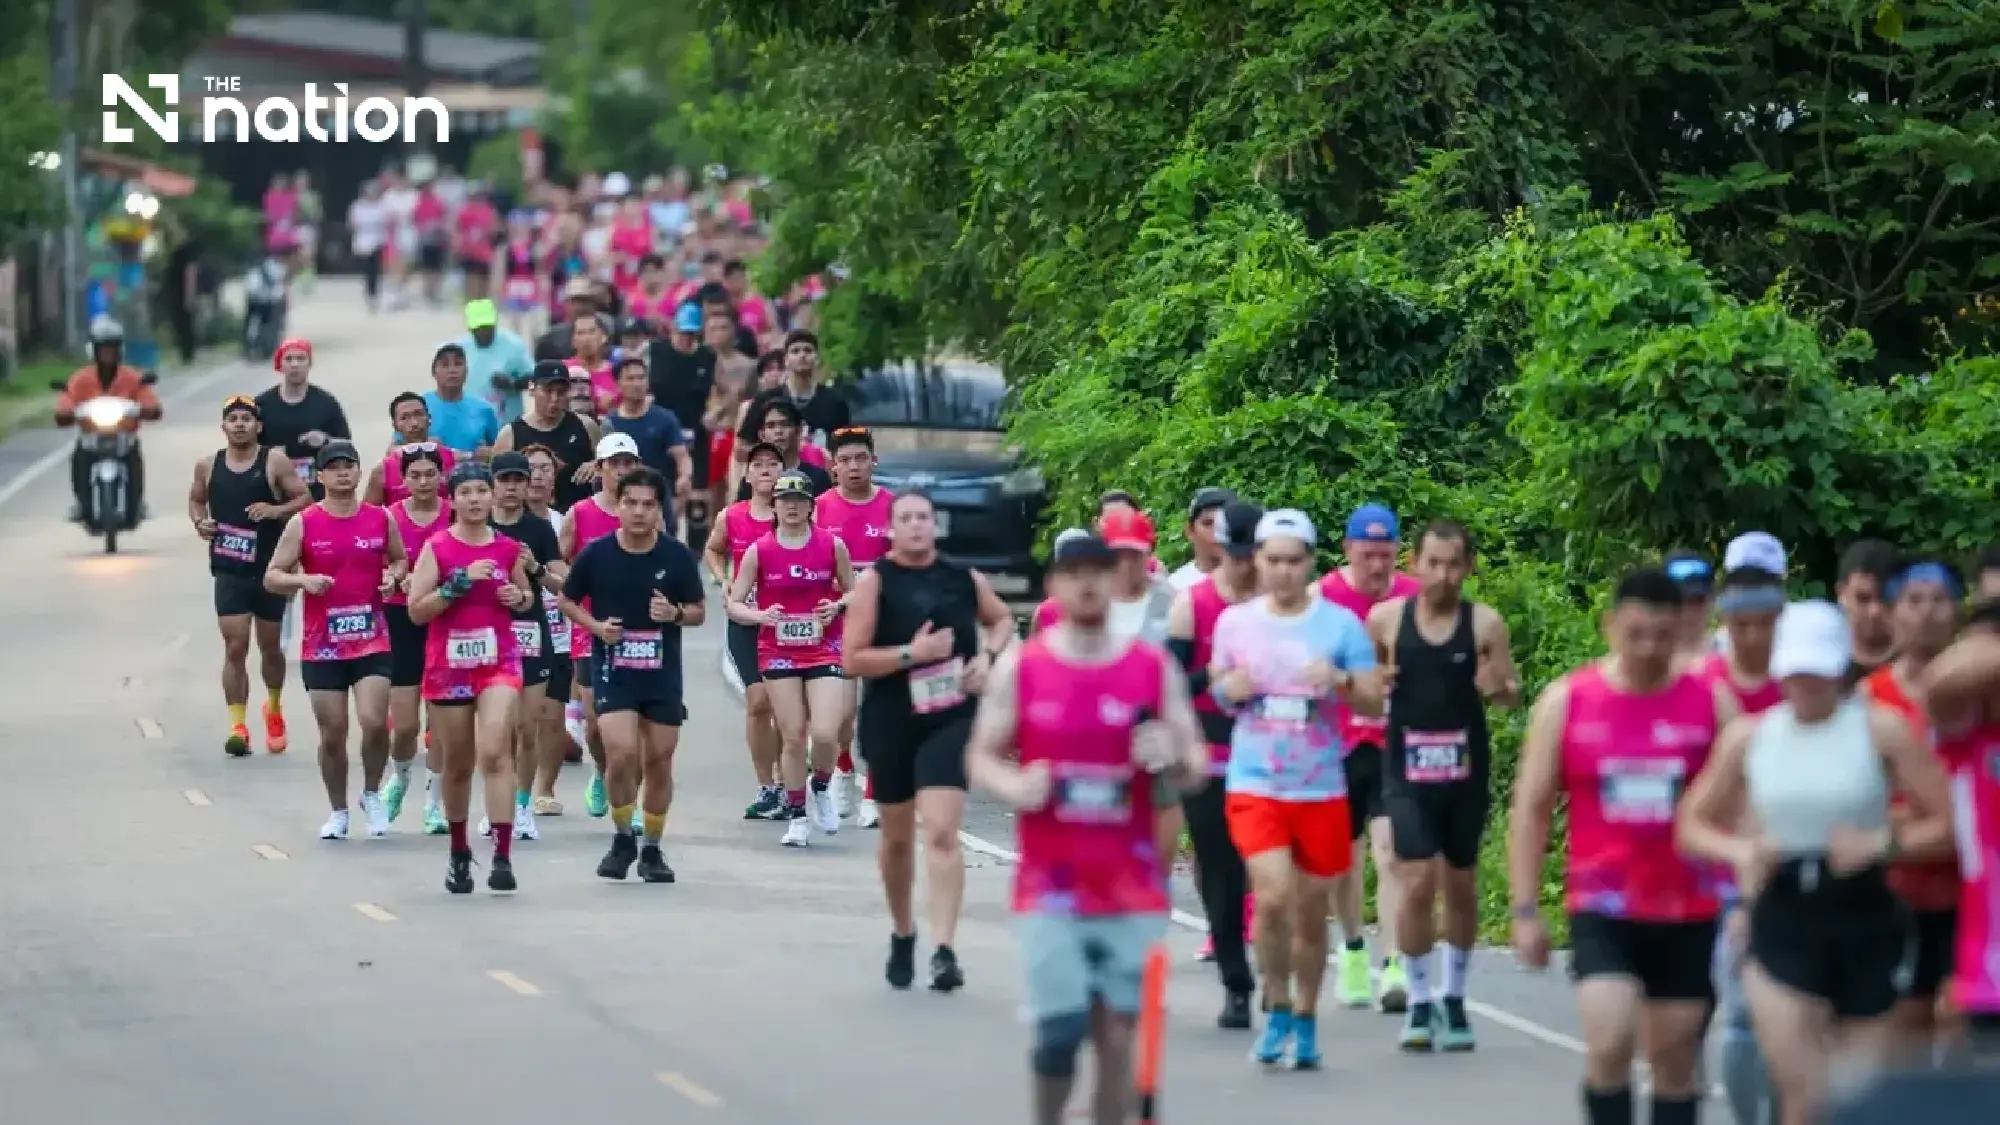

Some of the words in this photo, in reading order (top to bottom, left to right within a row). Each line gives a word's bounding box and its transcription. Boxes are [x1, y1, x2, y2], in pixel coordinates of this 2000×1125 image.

[336, 615, 366, 633] 2739
[782, 622, 813, 637] 4023
[456, 640, 487, 657] 4101
